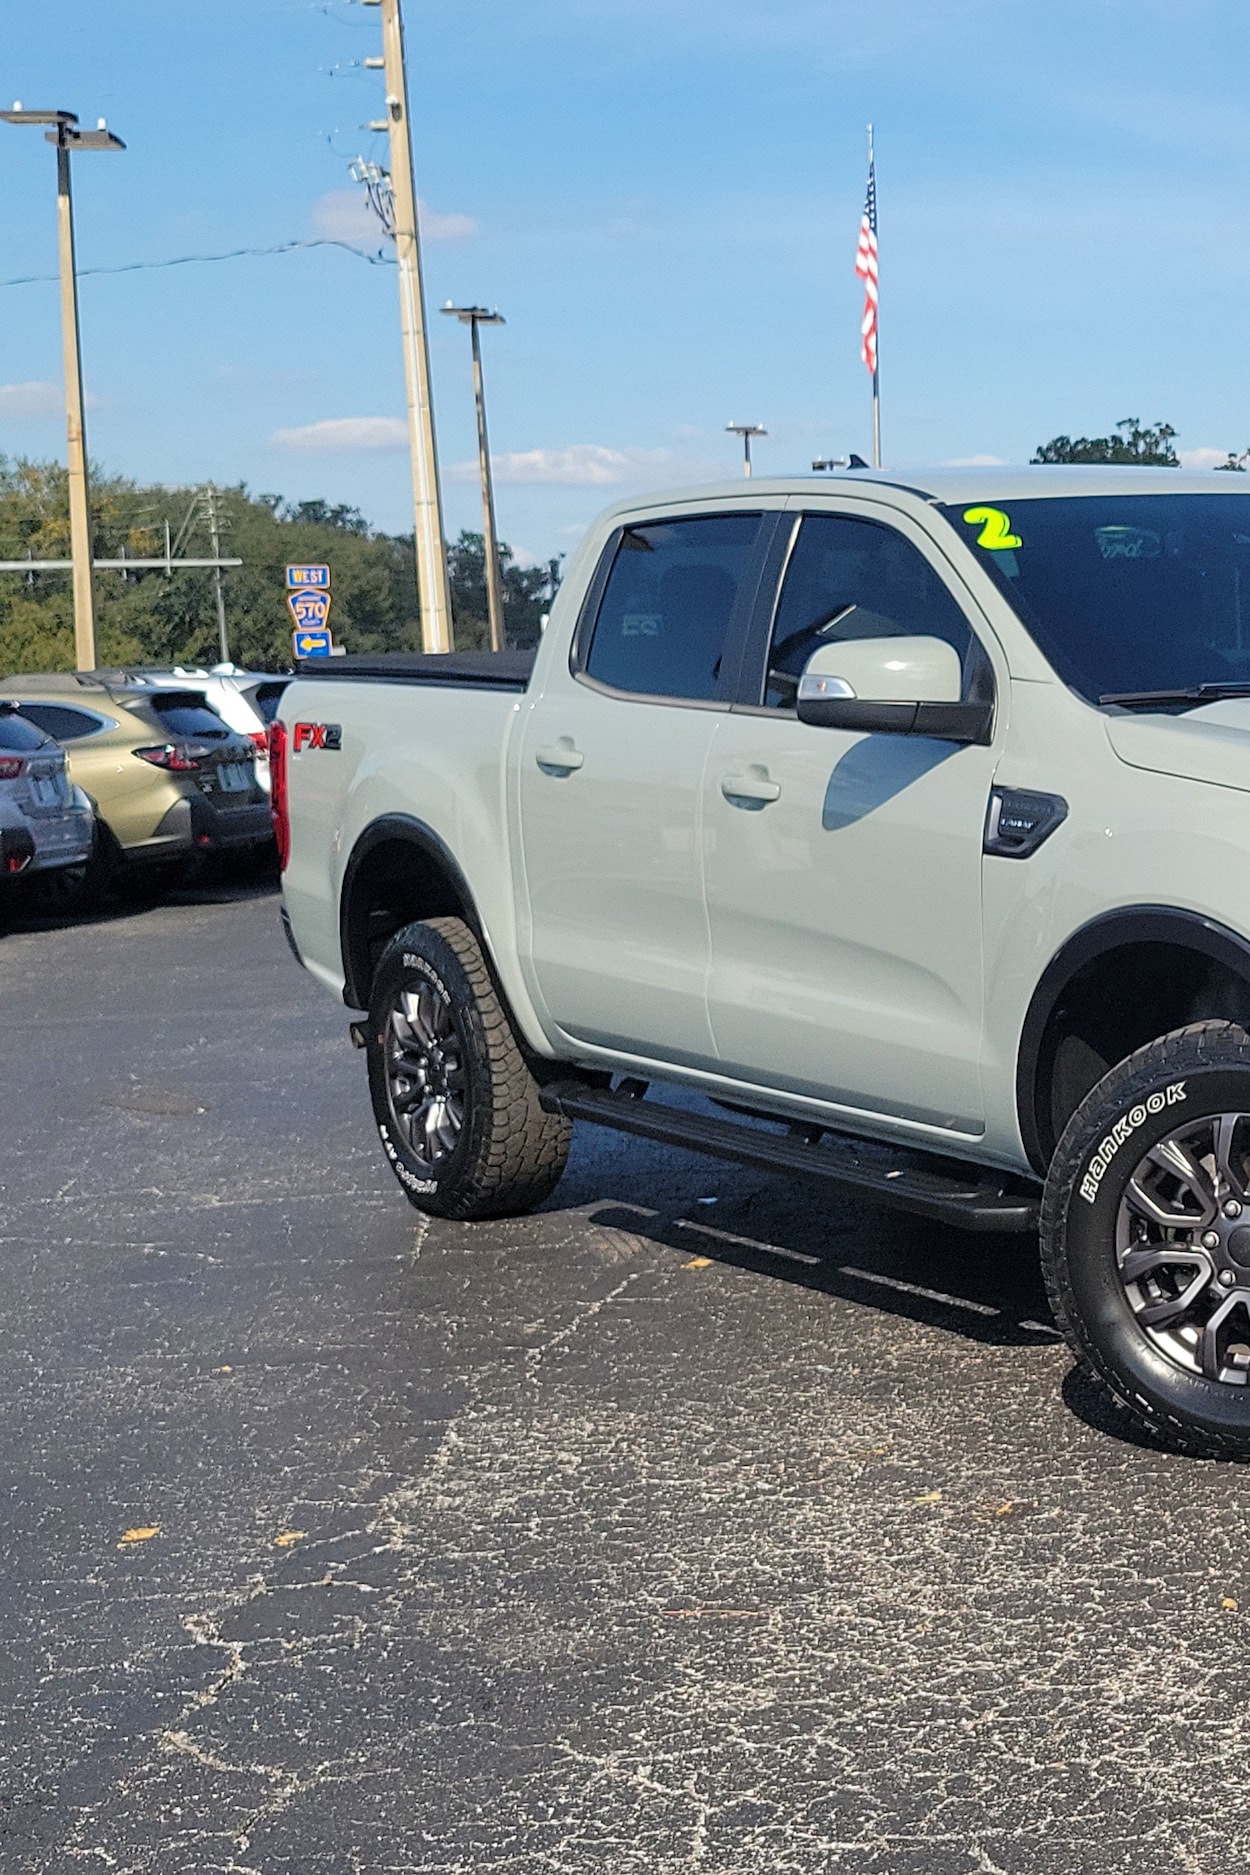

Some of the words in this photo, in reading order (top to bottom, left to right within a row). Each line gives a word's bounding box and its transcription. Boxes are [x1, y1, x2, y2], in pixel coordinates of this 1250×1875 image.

[963, 506, 1023, 550] 2
[292, 569, 323, 583] WEST
[295, 601, 326, 620] 570
[293, 722, 342, 752] FX2
